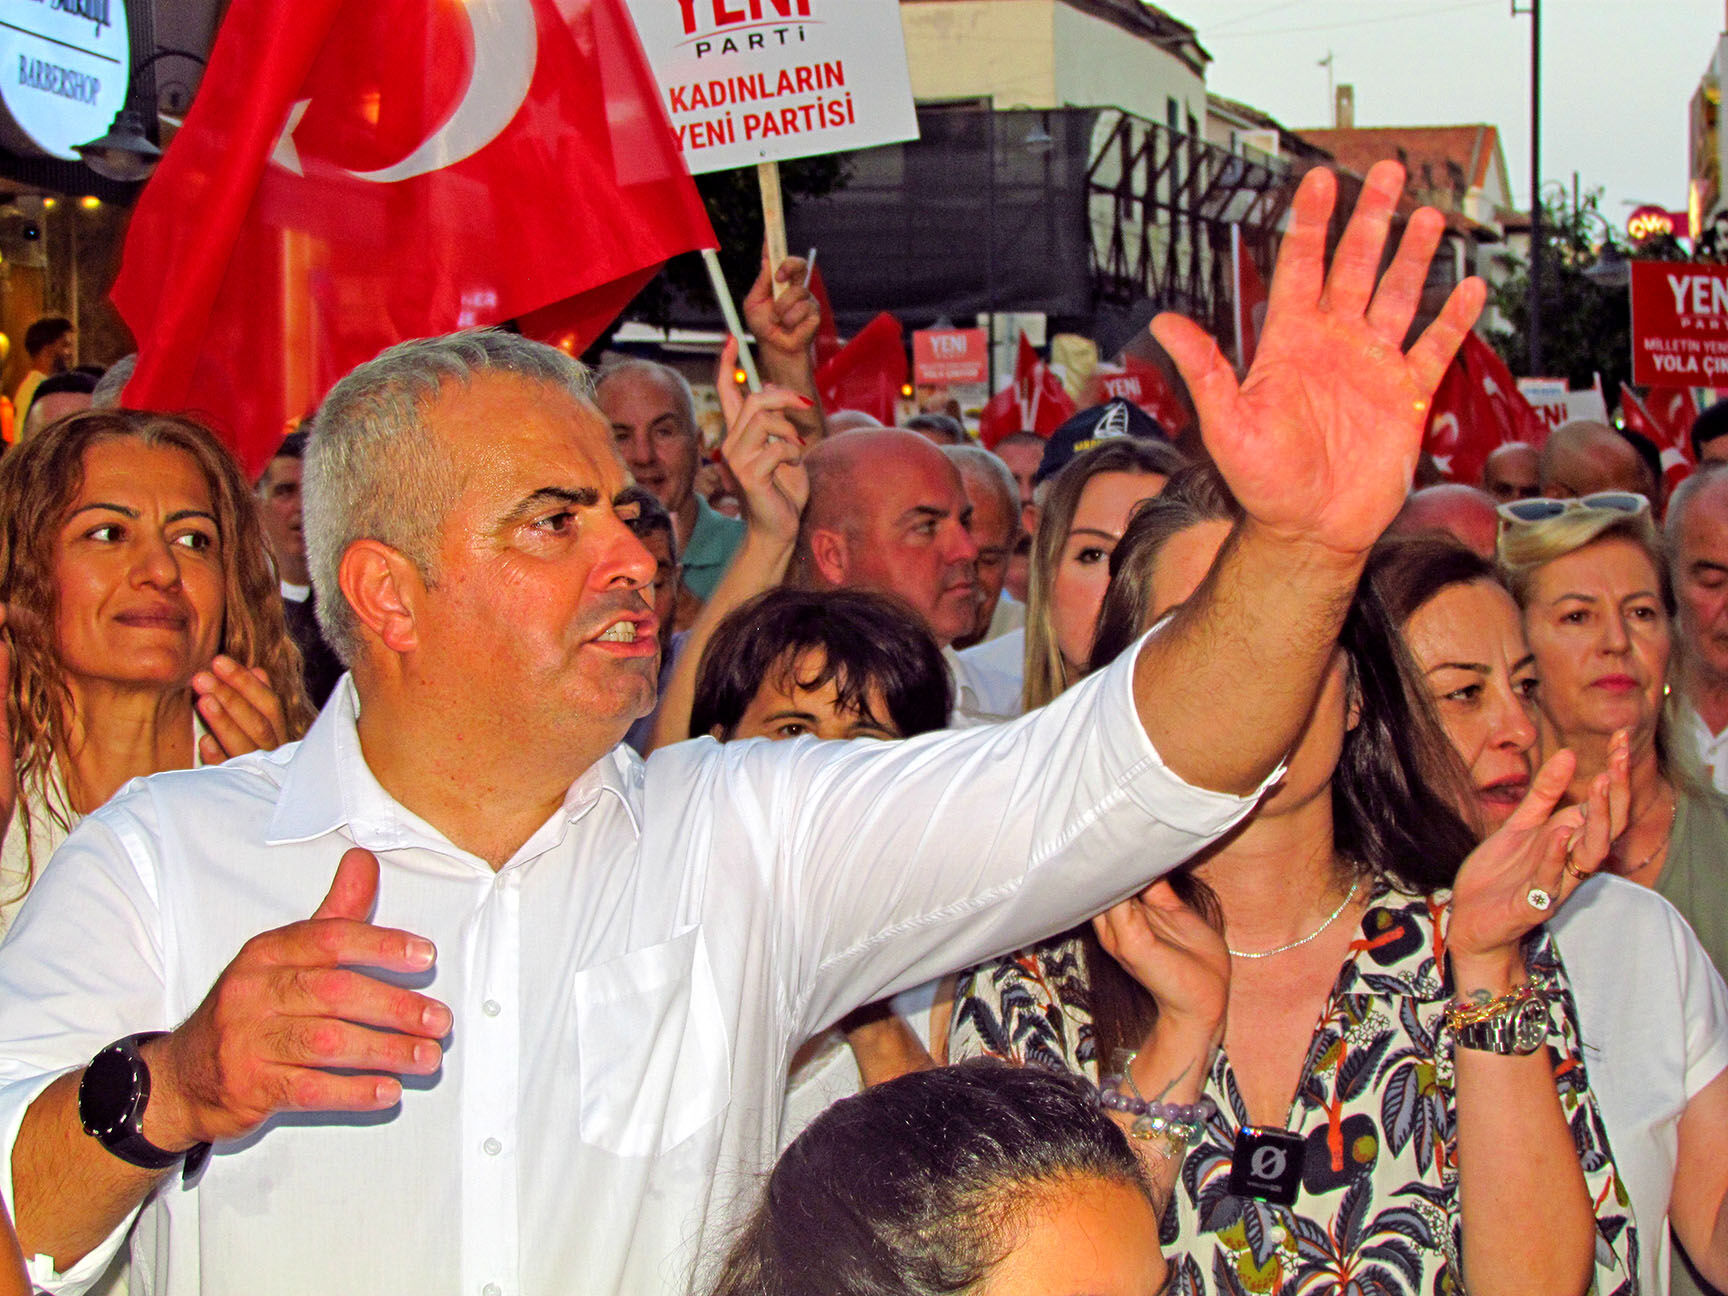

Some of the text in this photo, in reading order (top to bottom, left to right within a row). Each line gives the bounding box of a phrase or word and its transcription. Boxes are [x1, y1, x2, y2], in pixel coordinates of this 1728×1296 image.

[18, 54, 99, 106] BARBERSHOP
[669, 60, 845, 114] KADINLARIN
[674, 92, 855, 149] YENİ PARTİSİ
[1652, 352, 1699, 373] YOLA
